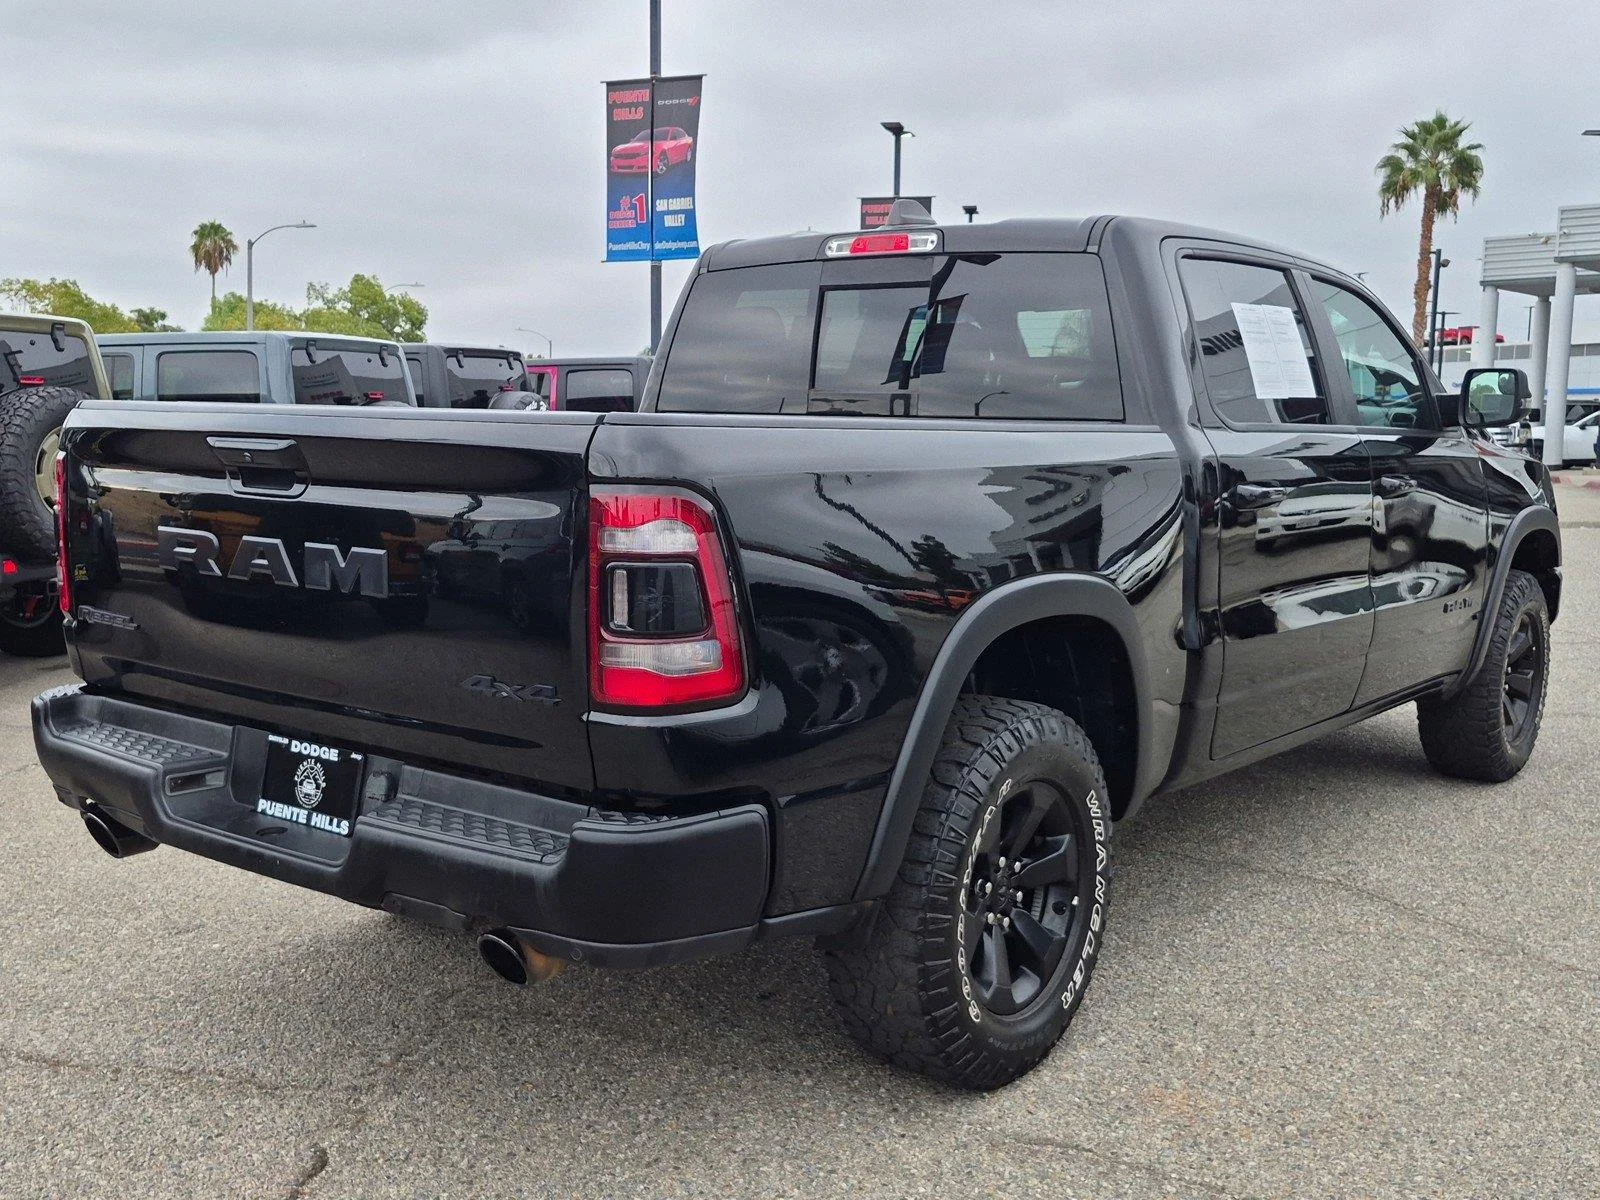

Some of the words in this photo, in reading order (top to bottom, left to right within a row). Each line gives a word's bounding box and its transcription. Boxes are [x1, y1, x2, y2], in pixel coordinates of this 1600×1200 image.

[608, 89, 650, 104] PUENTE
[613, 106, 644, 121] HILLS
[620, 193, 647, 223] #1
[656, 199, 668, 211] SAN
[669, 197, 693, 210] GABRIEL
[664, 214, 685, 227] VALLEY
[157, 525, 389, 599] RAM
[78, 605, 137, 630] REBEL
[290, 739, 339, 761] DODGE
[294, 759, 316, 781] PUENTE
[257, 799, 308, 824] PUENTE
[310, 812, 350, 835] HILLS
[1062, 789, 1107, 1010] WRANGLER
